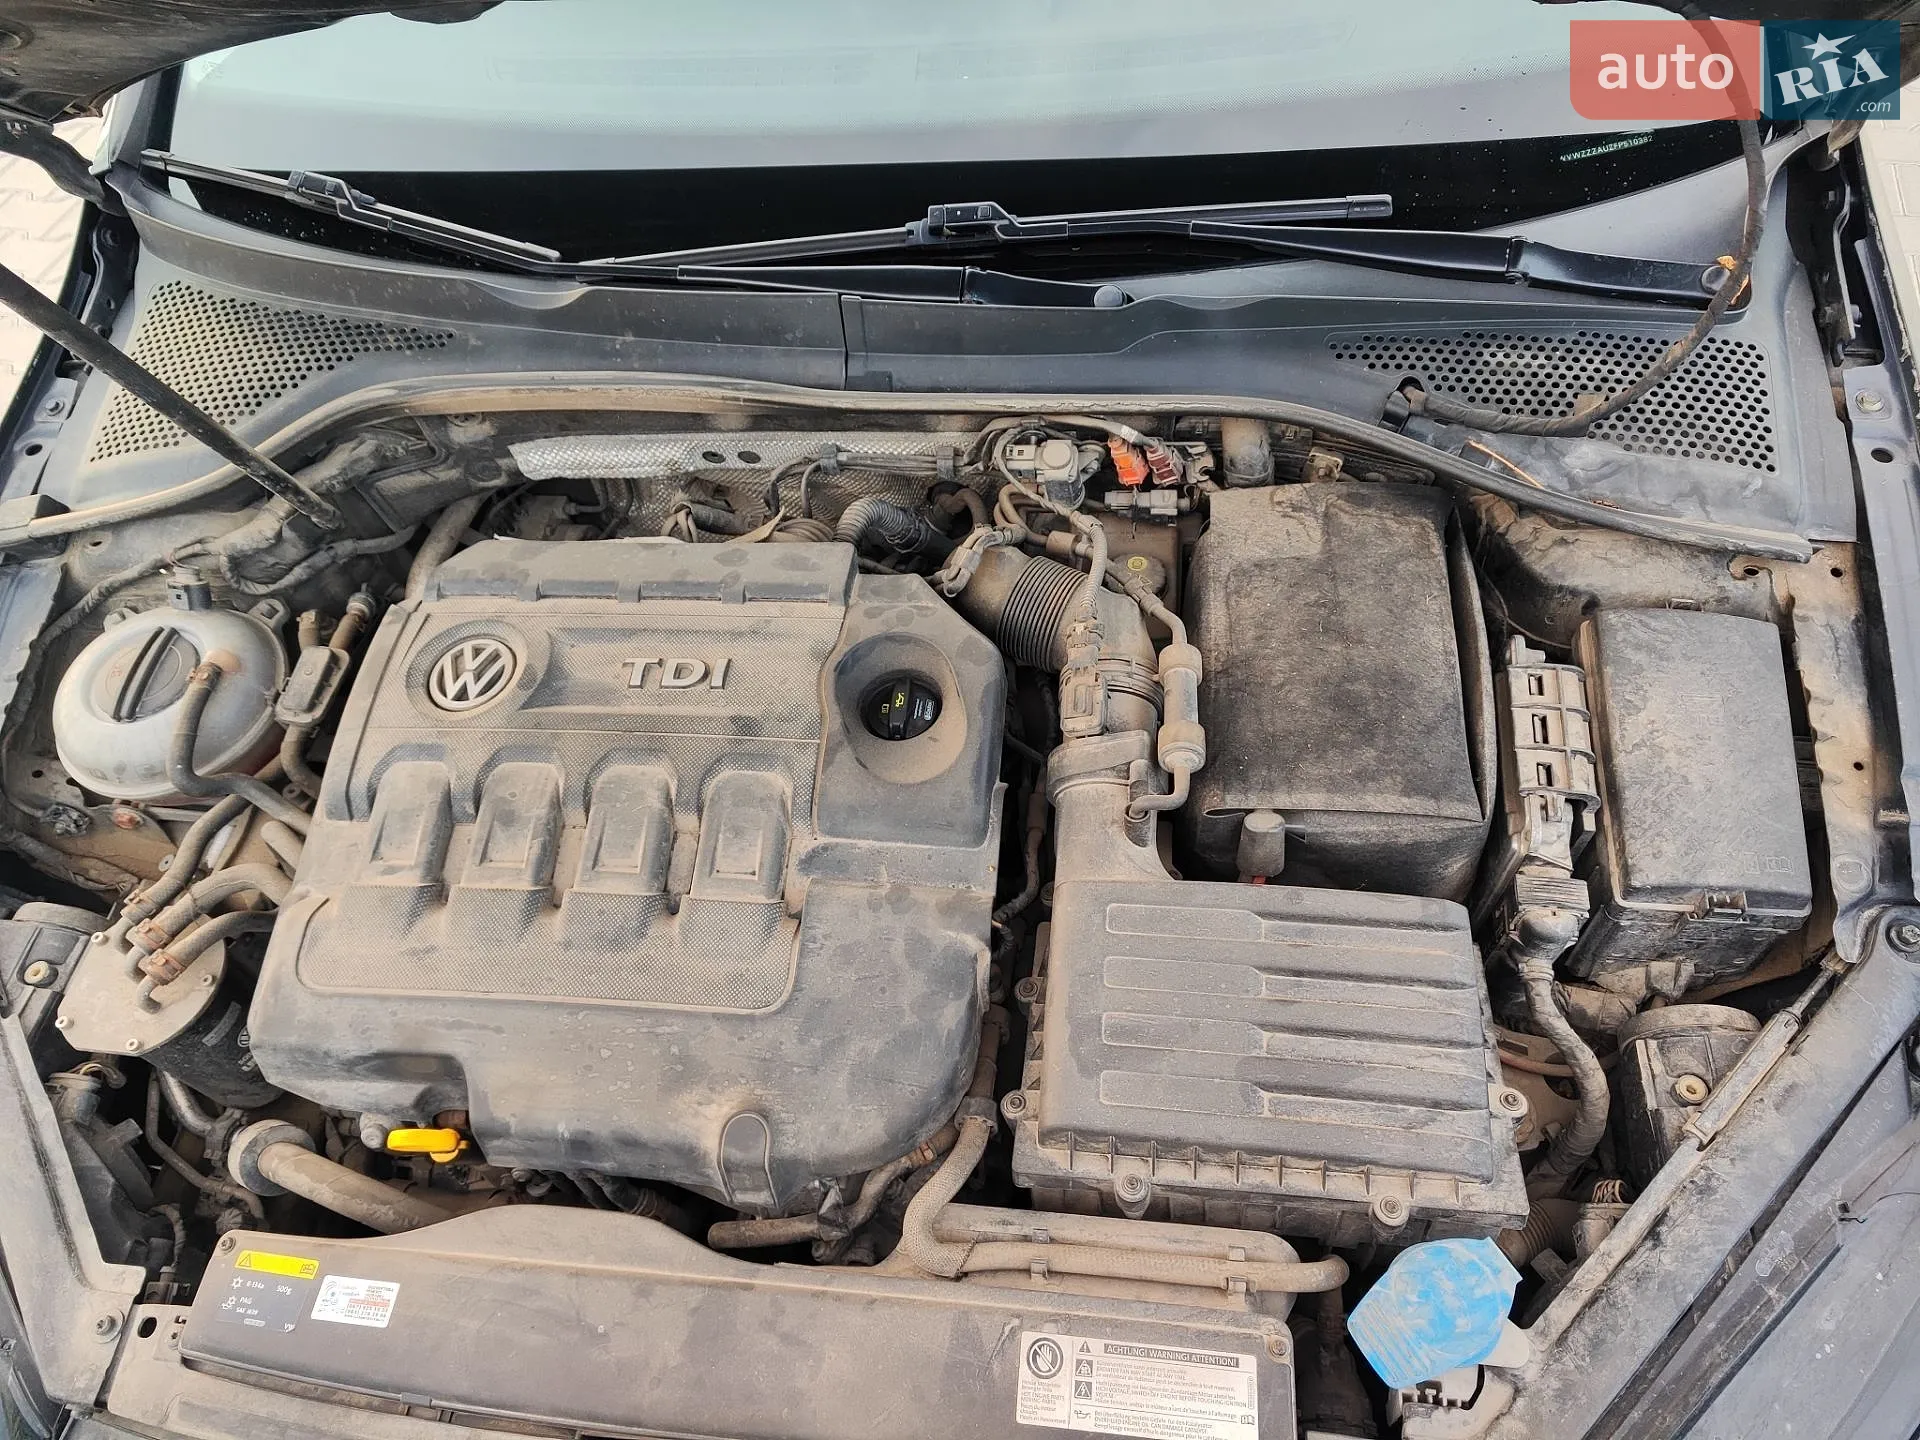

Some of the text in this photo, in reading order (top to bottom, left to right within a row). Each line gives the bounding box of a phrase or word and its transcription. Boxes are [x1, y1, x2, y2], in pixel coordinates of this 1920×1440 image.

[430, 639, 515, 710] VW
[622, 658, 731, 690] TDI
[1107, 1344, 1237, 1367] ACHTUNG! WARNING! ATTENTION!
